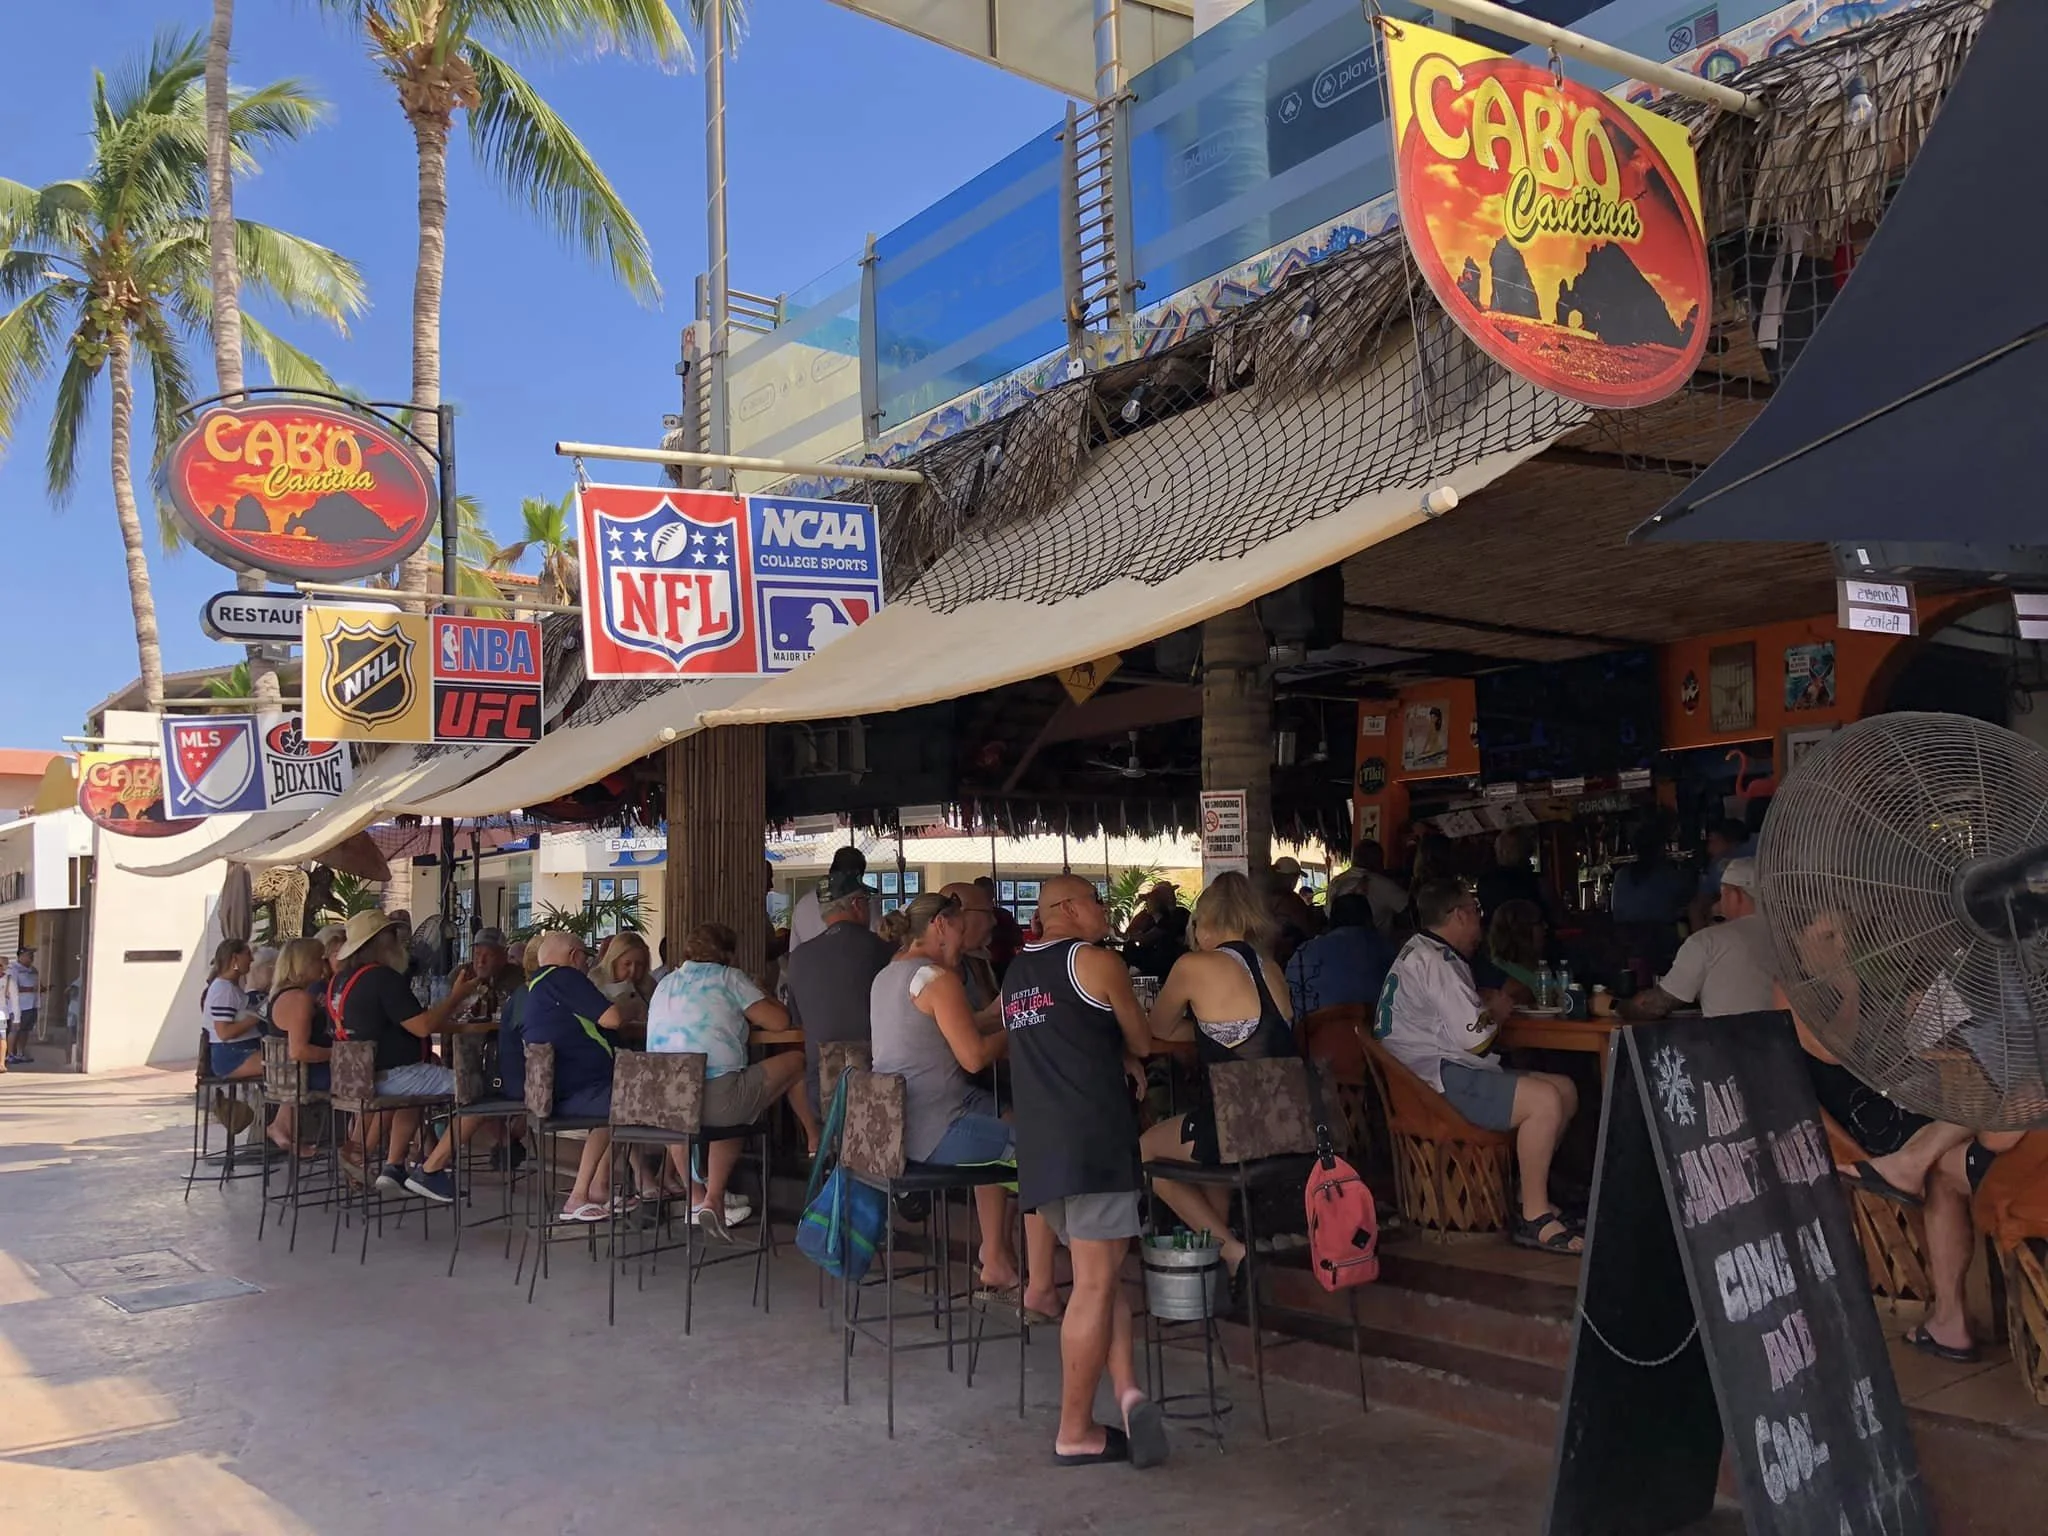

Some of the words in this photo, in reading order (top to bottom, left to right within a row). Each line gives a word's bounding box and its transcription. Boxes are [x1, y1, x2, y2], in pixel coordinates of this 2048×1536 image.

[1411, 53, 1621, 203] CABO
[1504, 167, 1642, 244] Cantina
[204, 415, 363, 475] CABO
[264, 463, 376, 500] Cantina
[761, 507, 866, 552] NCAA
[760, 554, 819, 570] COLLEGE
[821, 556, 868, 572] SPORTS
[617, 571, 729, 644] NFL
[463, 626, 536, 675] NBA
[773, 652, 800, 661] MAJOR
[342, 650, 398, 704] NHL
[438, 691, 537, 739] UFC
[181, 730, 221, 749] MLS
[274, 758, 343, 798] BOXING
[611, 838, 647, 851] BAJA
[1011, 986, 1040, 1001] HUSTLER
[1013, 1007, 1039, 1020] XXX
[1029, 992, 1055, 1010] LEGAL
[1028, 1014, 1047, 1026] SCOUT
[1715, 1232, 1798, 1322] COME
[1761, 1309, 1817, 1392] AND
[1755, 1412, 1830, 1505] COOL
